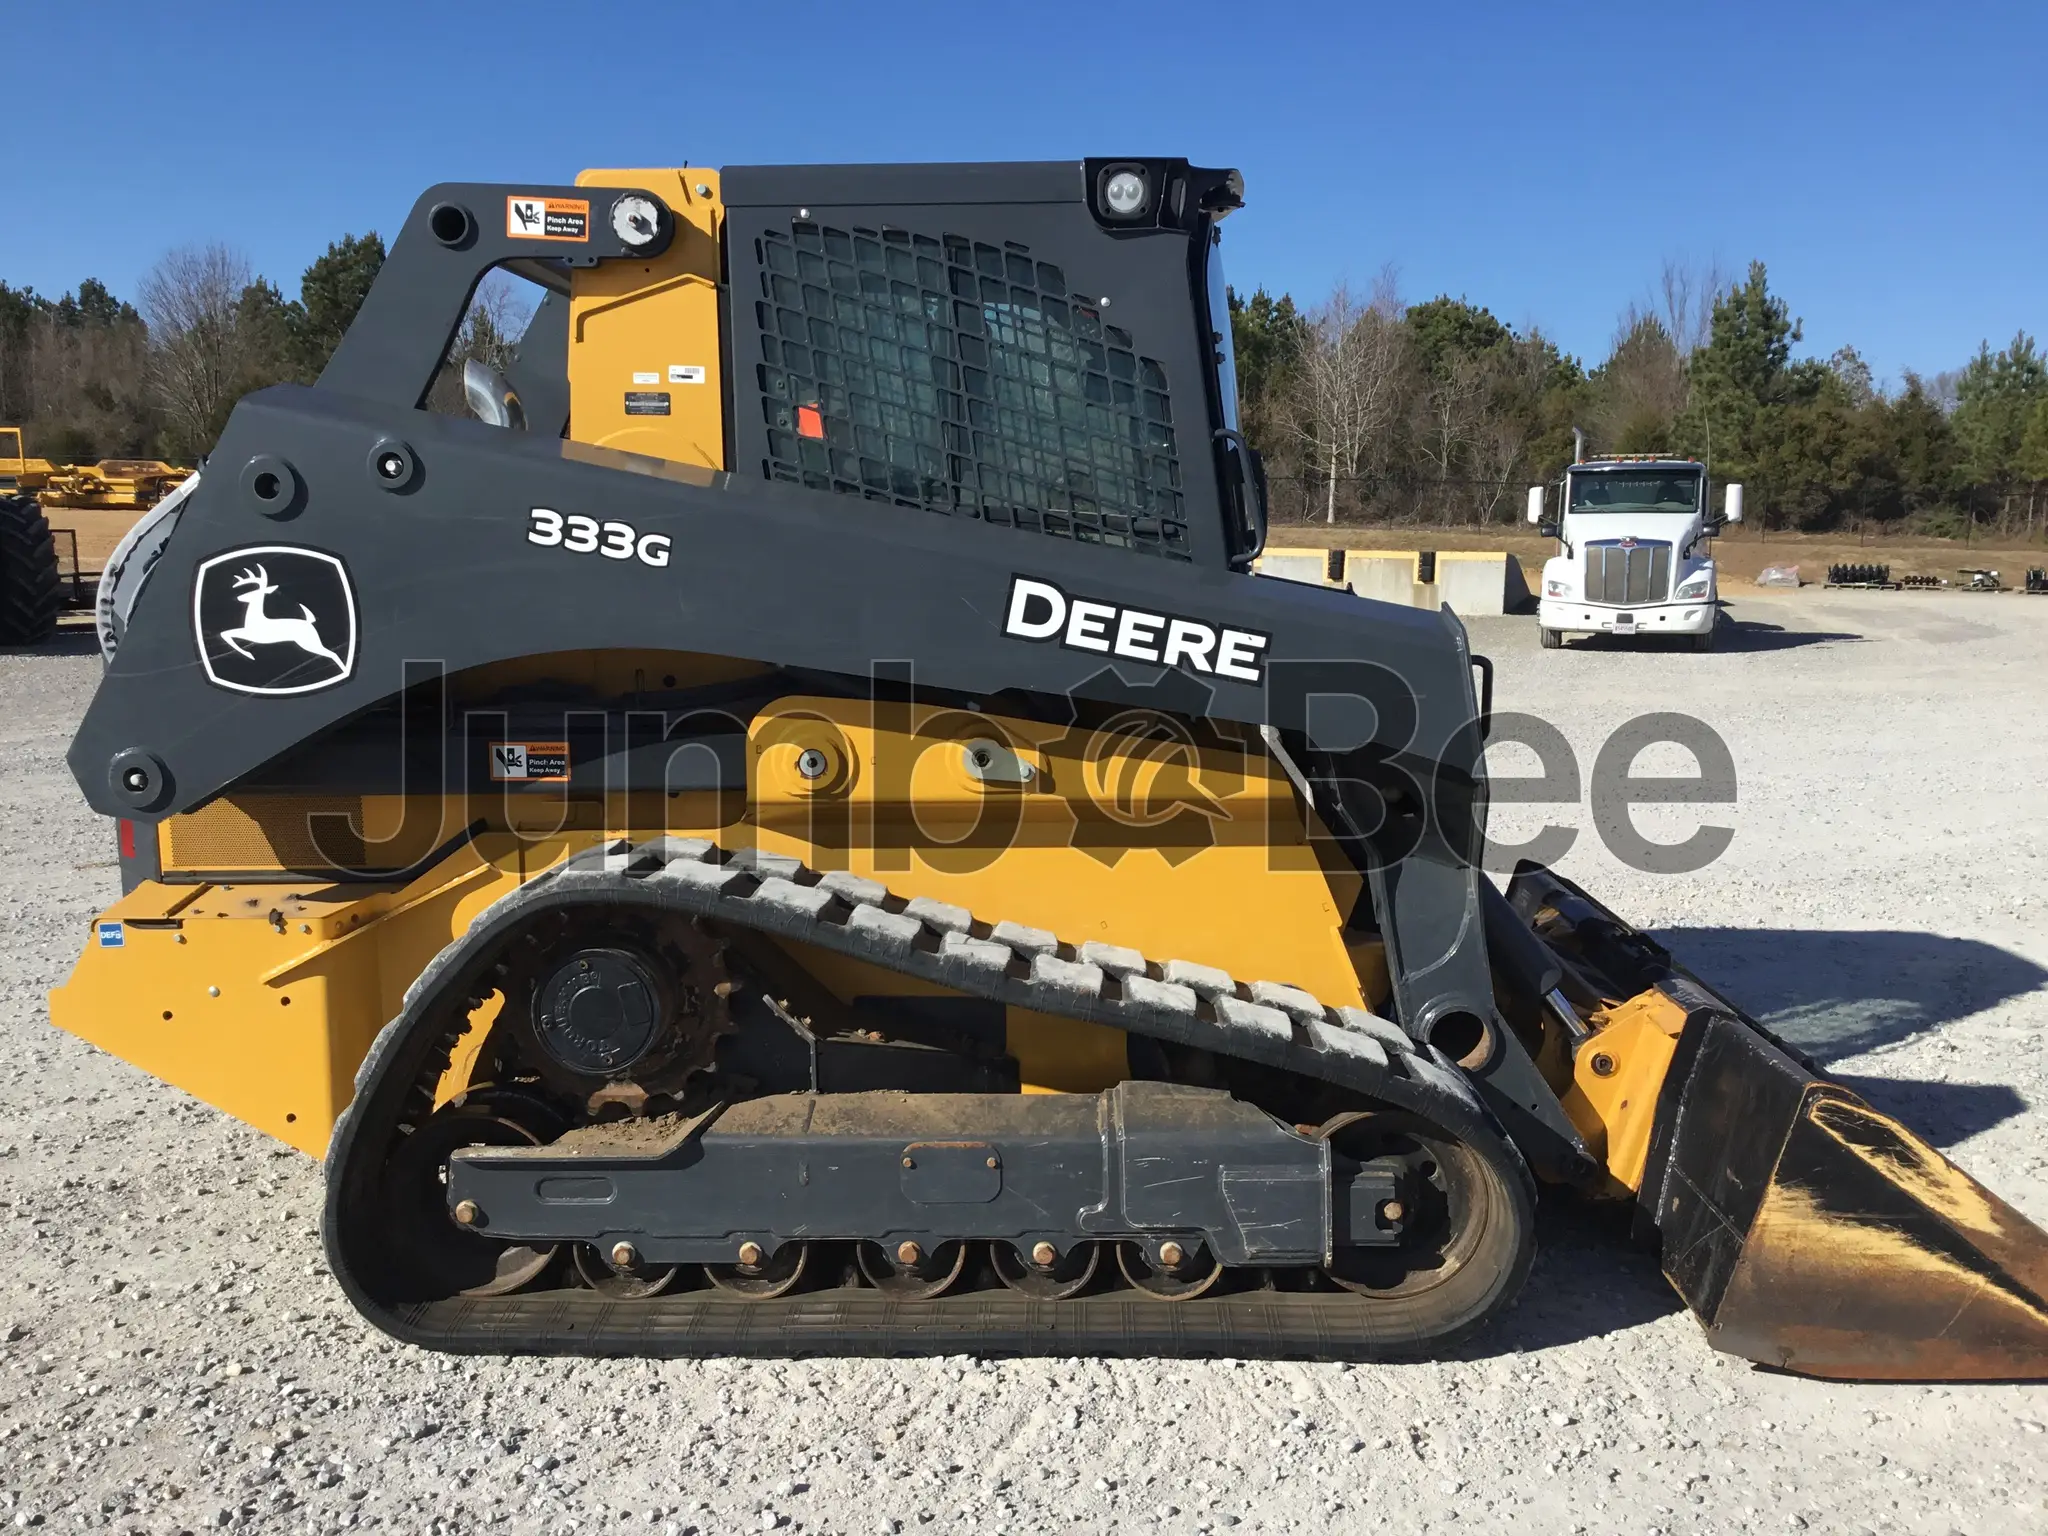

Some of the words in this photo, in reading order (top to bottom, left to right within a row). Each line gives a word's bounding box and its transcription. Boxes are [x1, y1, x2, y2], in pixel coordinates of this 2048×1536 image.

[547, 216, 567, 224] Pinch
[563, 226, 579, 234] Away
[527, 508, 672, 567] 333G
[1005, 578, 1267, 682] DEERE
